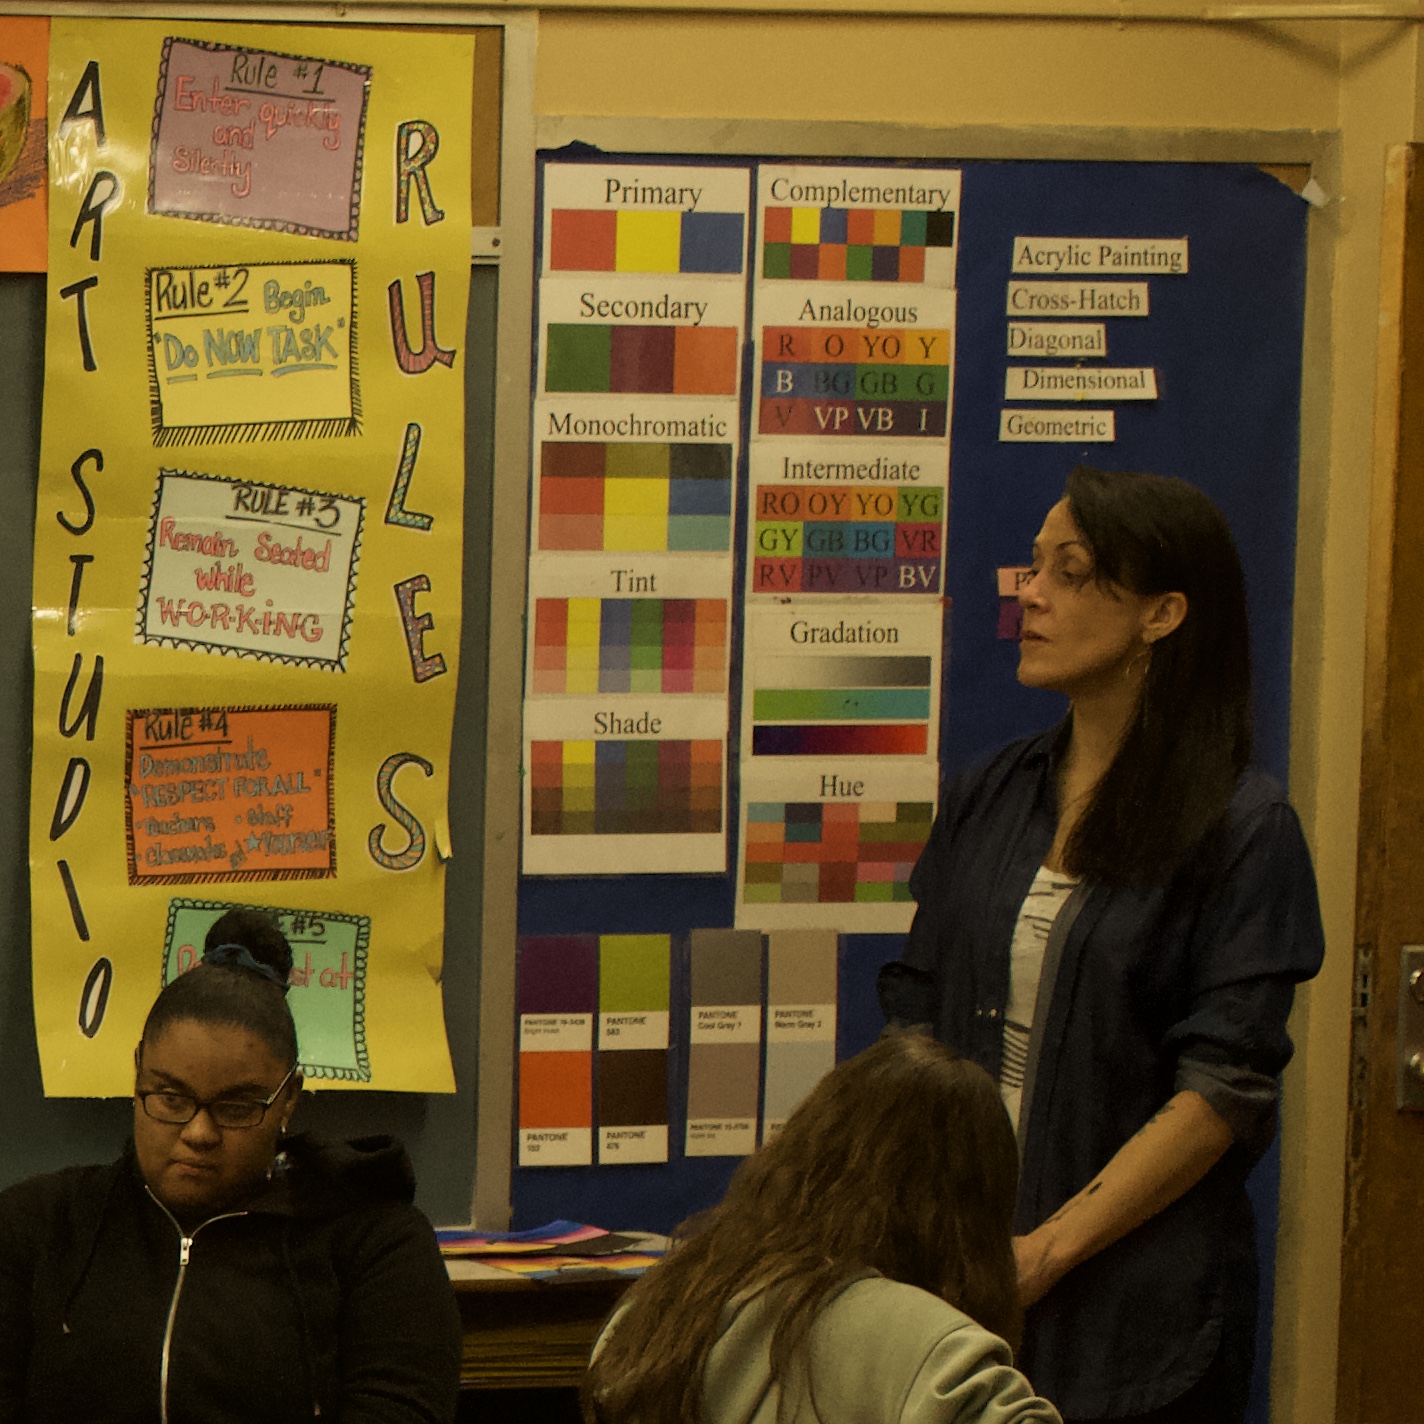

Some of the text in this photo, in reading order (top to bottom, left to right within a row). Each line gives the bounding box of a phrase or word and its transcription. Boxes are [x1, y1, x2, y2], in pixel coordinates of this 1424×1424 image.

[231, 53, 325, 95] Rule #1
[174, 75, 341, 150] Enter quickly
[212, 118, 255, 150] and
[604, 178, 703, 212] Primary
[770, 178, 951, 209] Complementary
[1017, 245, 1183, 273] Acrylic Painting
[156, 268, 249, 312] Rule #2
[264, 279, 331, 324] Begin
[1011, 289, 1140, 312] Cross-Hatch
[579, 293, 708, 325] Secondary
[798, 299, 919, 328] Analogous
[203, 328, 262, 367] NOW
[779, 334, 937, 359] R O YO Y
[1009, 328, 1104, 353] Diagonal
[776, 369, 934, 395] B BG GB G
[1022, 369, 1146, 392] Dimensional
[548, 413, 728, 438] Monochromatic
[814, 406, 849, 431] VP
[857, 407, 894, 431] VB
[919, 408, 928, 431] I
[1006, 415, 1108, 437] Geometric
[783, 456, 921, 481] Intermediate
[232, 484, 341, 529] RULE #3
[762, 492, 939, 517] RO OY YO YG
[50, 60, 120, 1039] ART STUDIO
[159, 516, 332, 573] Remain Seated
[759, 528, 936, 552] GY GB BG VR
[194, 561, 256, 597] while
[610, 569, 657, 594] Tint
[760, 564, 937, 589] RV PV VP BV
[790, 621, 900, 645] Gradation
[144, 710, 229, 742] Rule #4
[593, 712, 662, 736] Shade
[139, 735, 272, 779] Demonstrate
[819, 775, 864, 798] Hue
[319, 951, 353, 990] at
[527, 1133, 568, 1141] PANTONE
